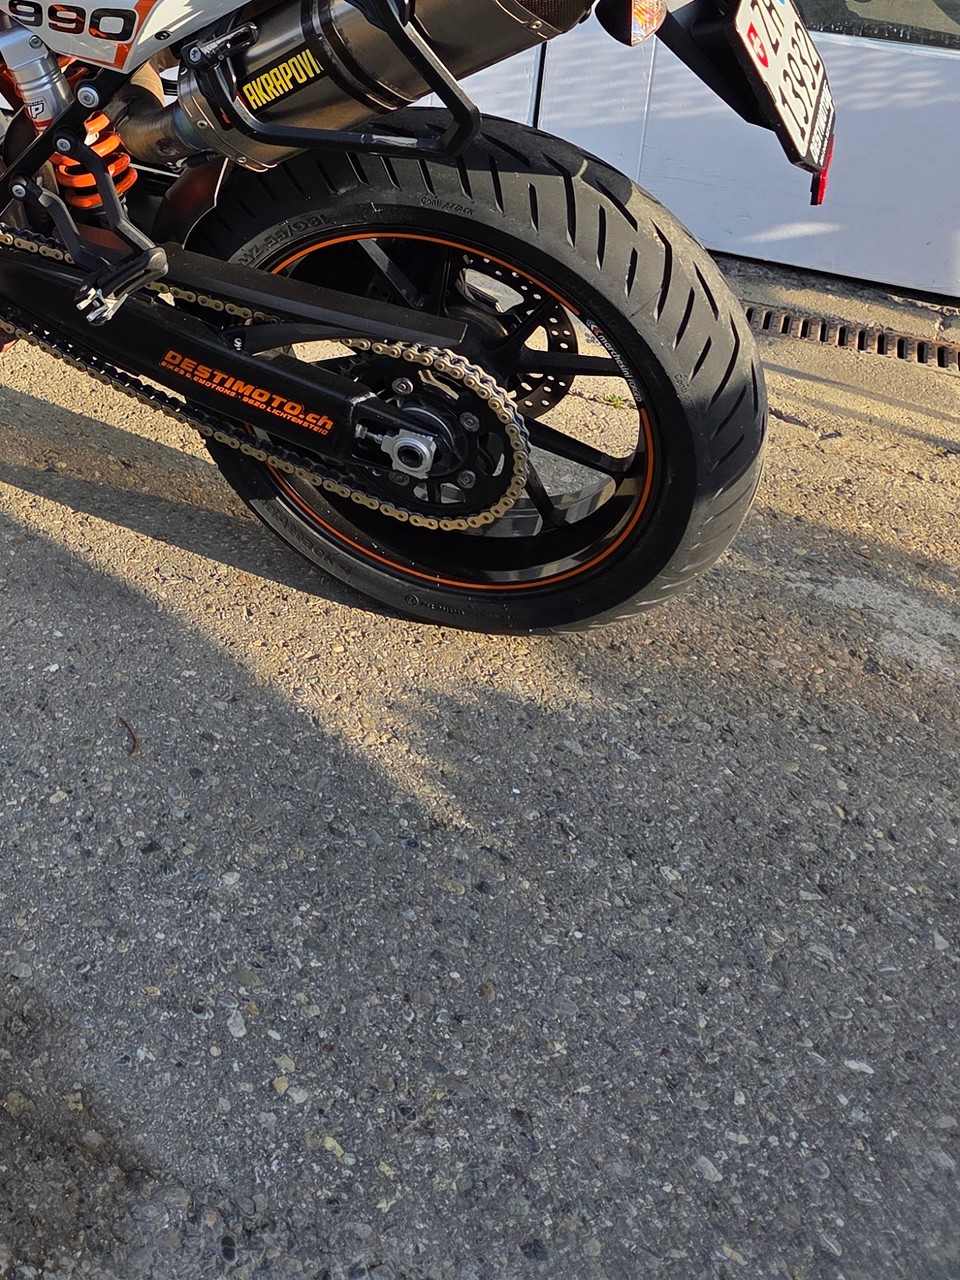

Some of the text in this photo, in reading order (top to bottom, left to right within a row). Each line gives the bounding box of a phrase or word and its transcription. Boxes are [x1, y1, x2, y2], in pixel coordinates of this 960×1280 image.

[8, 0, 137, 42] 990
[242, 48, 324, 110] AKRAPOVI
[778, 21, 821, 141] 13932
[160, 361, 186, 375] BIKES
[193, 376, 237, 398] EMOTIONS
[162, 350, 334, 431] DESTIMOTO.ch
